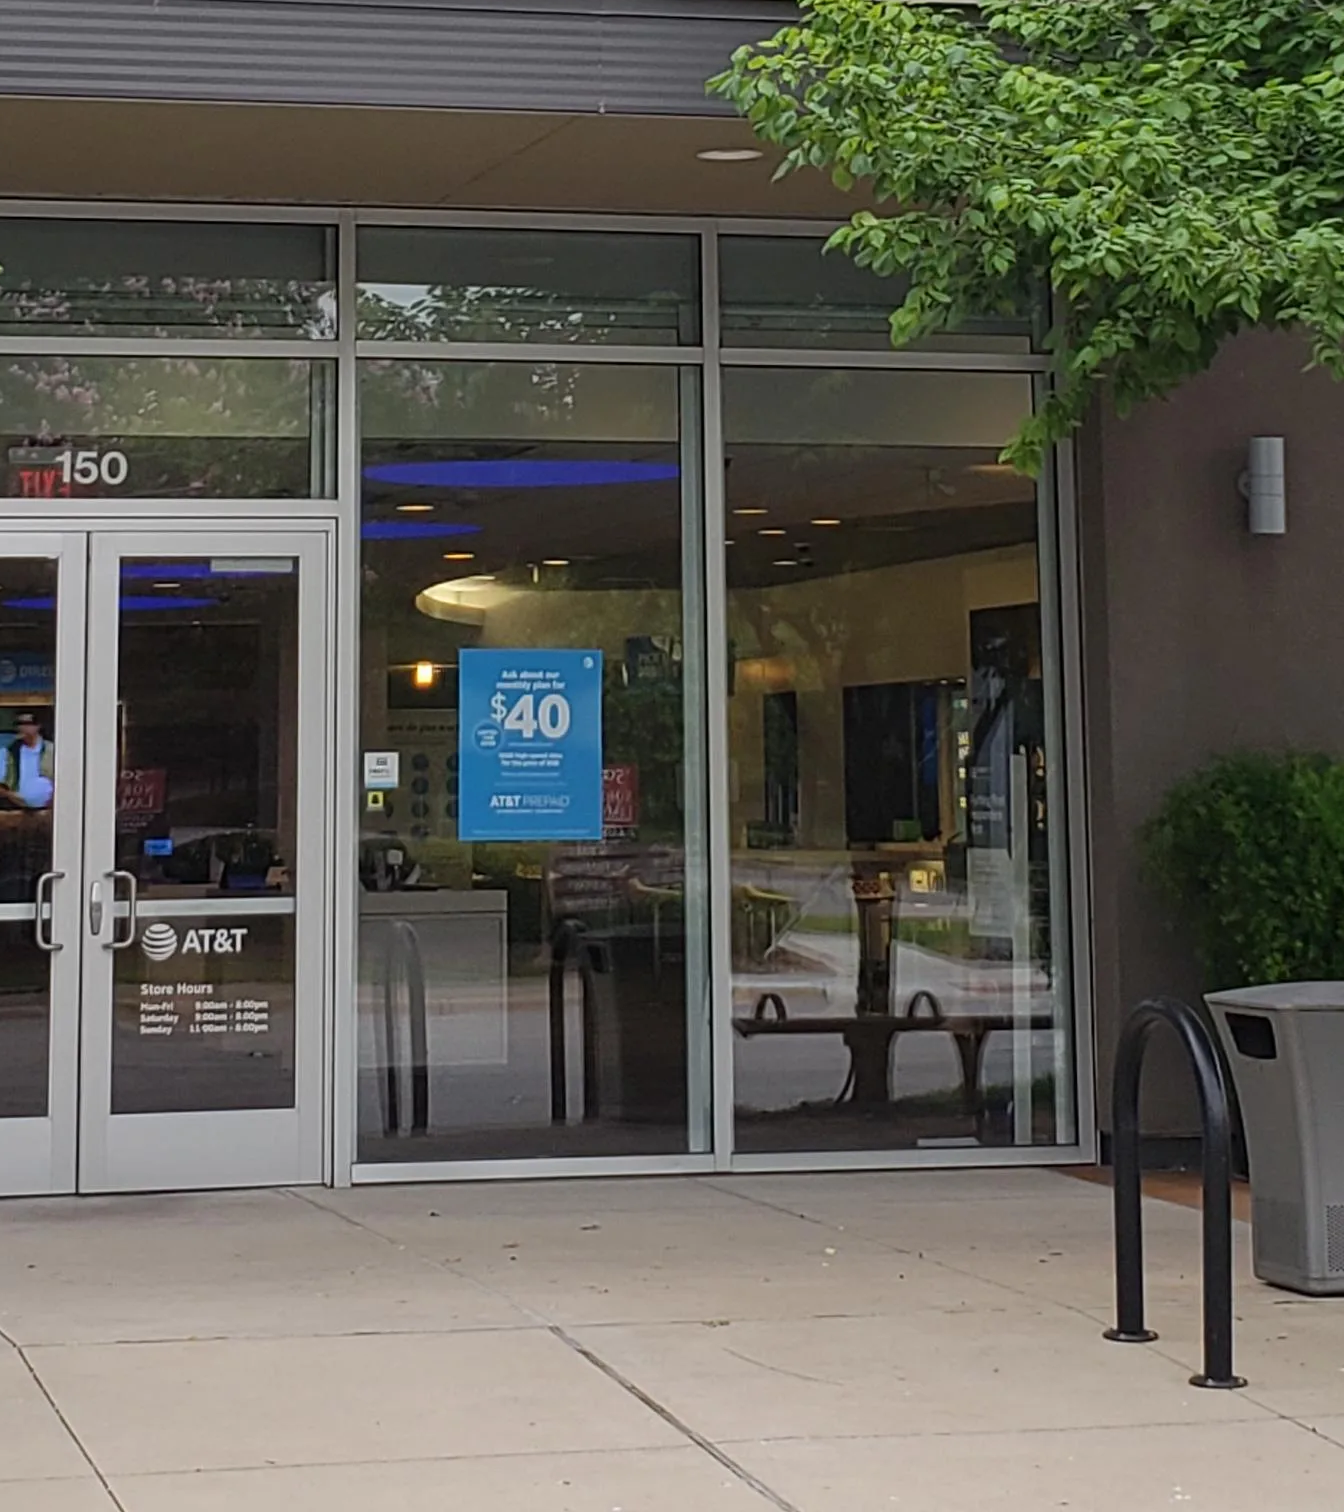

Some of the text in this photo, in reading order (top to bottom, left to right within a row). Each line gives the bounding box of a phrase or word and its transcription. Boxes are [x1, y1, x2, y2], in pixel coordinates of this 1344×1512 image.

[54, 450, 128, 485] 150
[502, 670, 518, 679] Ask
[519, 670, 544, 679] about
[496, 680, 531, 691] monthly
[552, 680, 566, 689] for
[490, 691, 571, 739] $40
[489, 794, 522, 808] AT&T
[181, 928, 249, 954] AT&T
[140, 982, 214, 995] Store Hours
[140, 1013, 180, 1025] Saturday
[140, 1025, 173, 1036] Sunday
